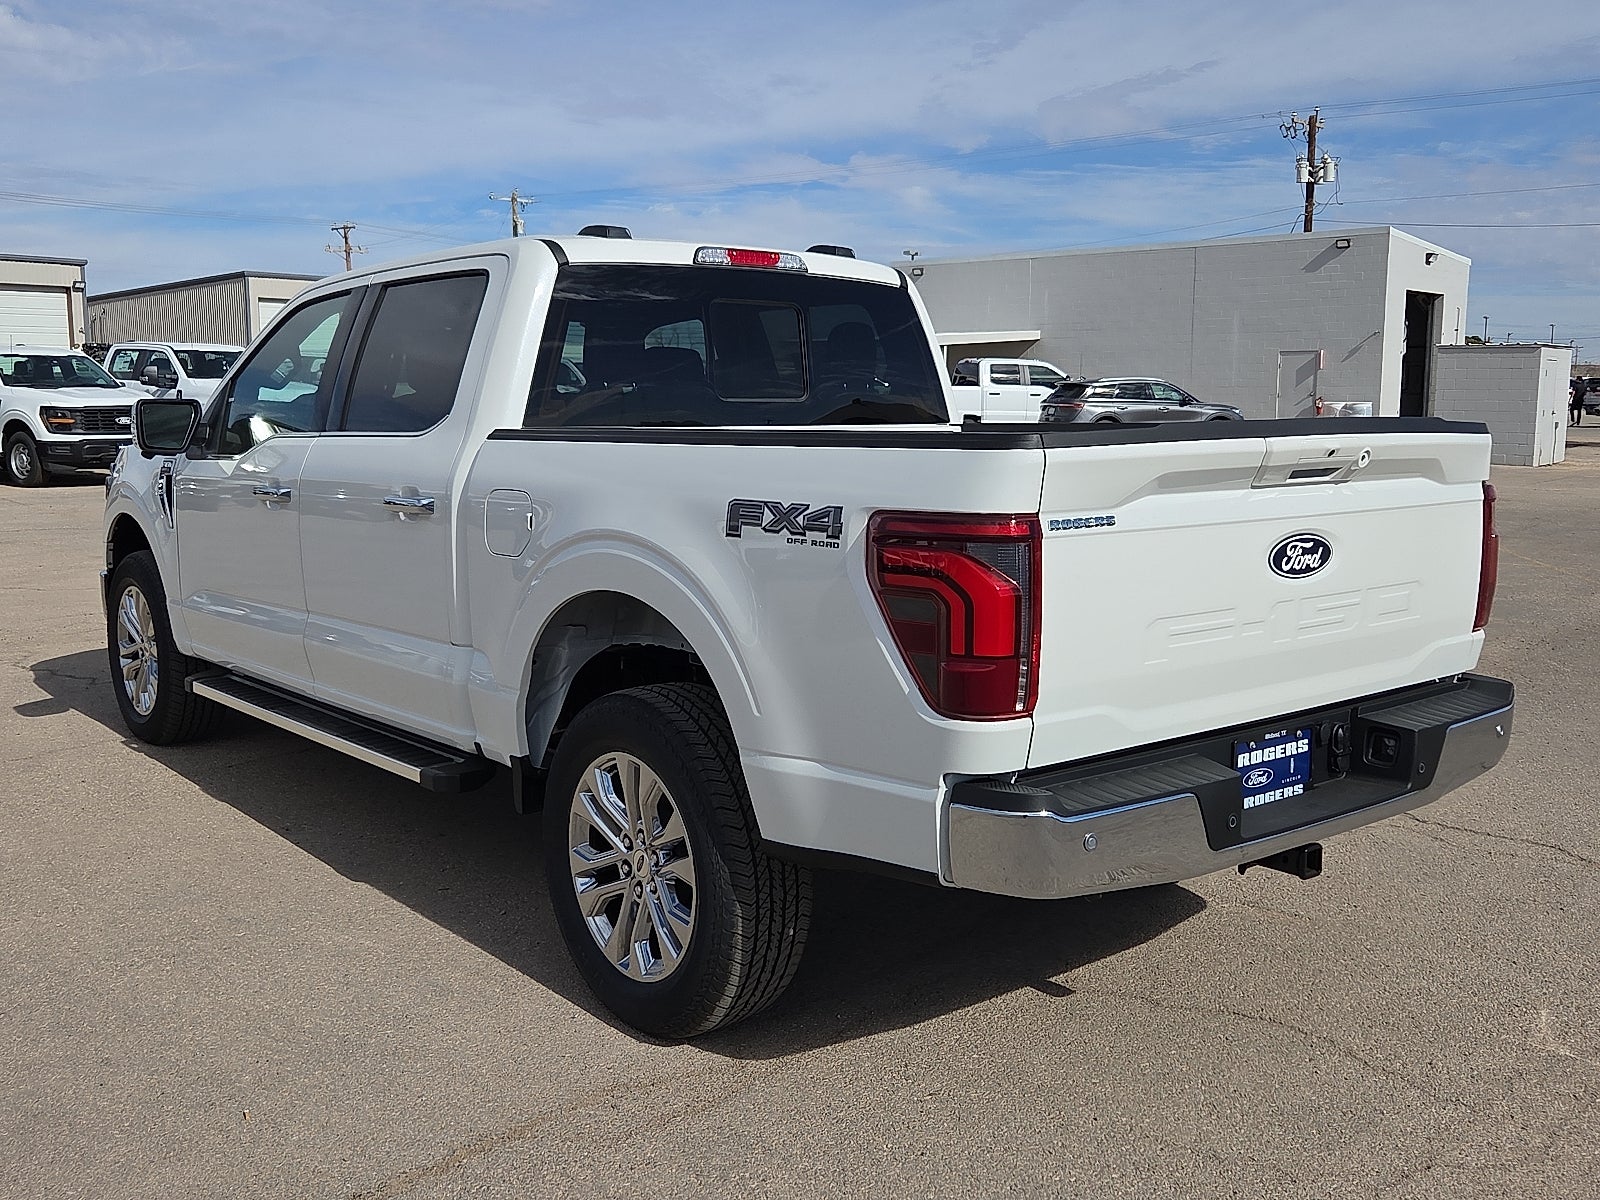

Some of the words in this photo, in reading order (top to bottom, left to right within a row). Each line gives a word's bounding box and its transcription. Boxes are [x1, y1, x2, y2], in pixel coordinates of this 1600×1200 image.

[725, 499, 843, 540] FX4
[1048, 515, 1116, 531] ROGERS
[786, 538, 808, 546] OFF
[811, 540, 840, 549] ROAD
[1282, 541, 1324, 571] Ford
[1237, 739, 1309, 768] ROGERS
[1248, 771, 1268, 786] Ford
[1243, 784, 1304, 809] ROGERS
